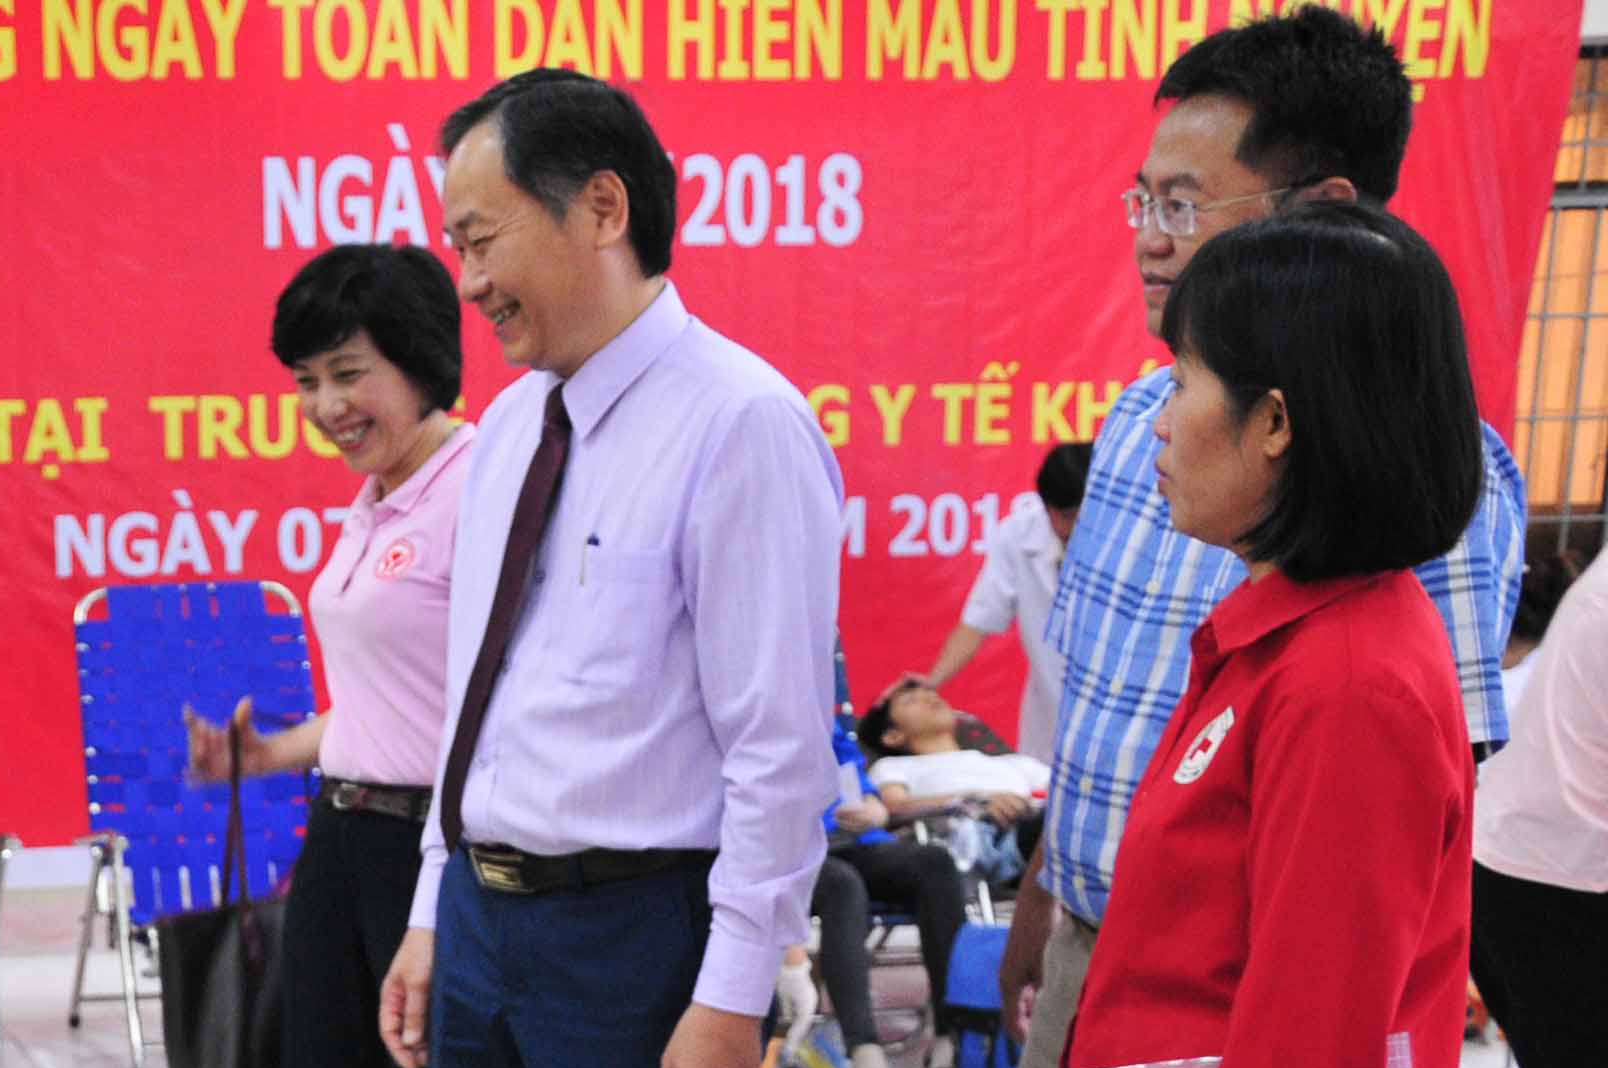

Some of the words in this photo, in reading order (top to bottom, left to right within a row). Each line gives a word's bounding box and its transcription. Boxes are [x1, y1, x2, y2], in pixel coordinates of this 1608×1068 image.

[869, 384, 916, 446] Y
[931, 360, 1021, 445] TẾ
[54, 489, 258, 579] NGÀY
